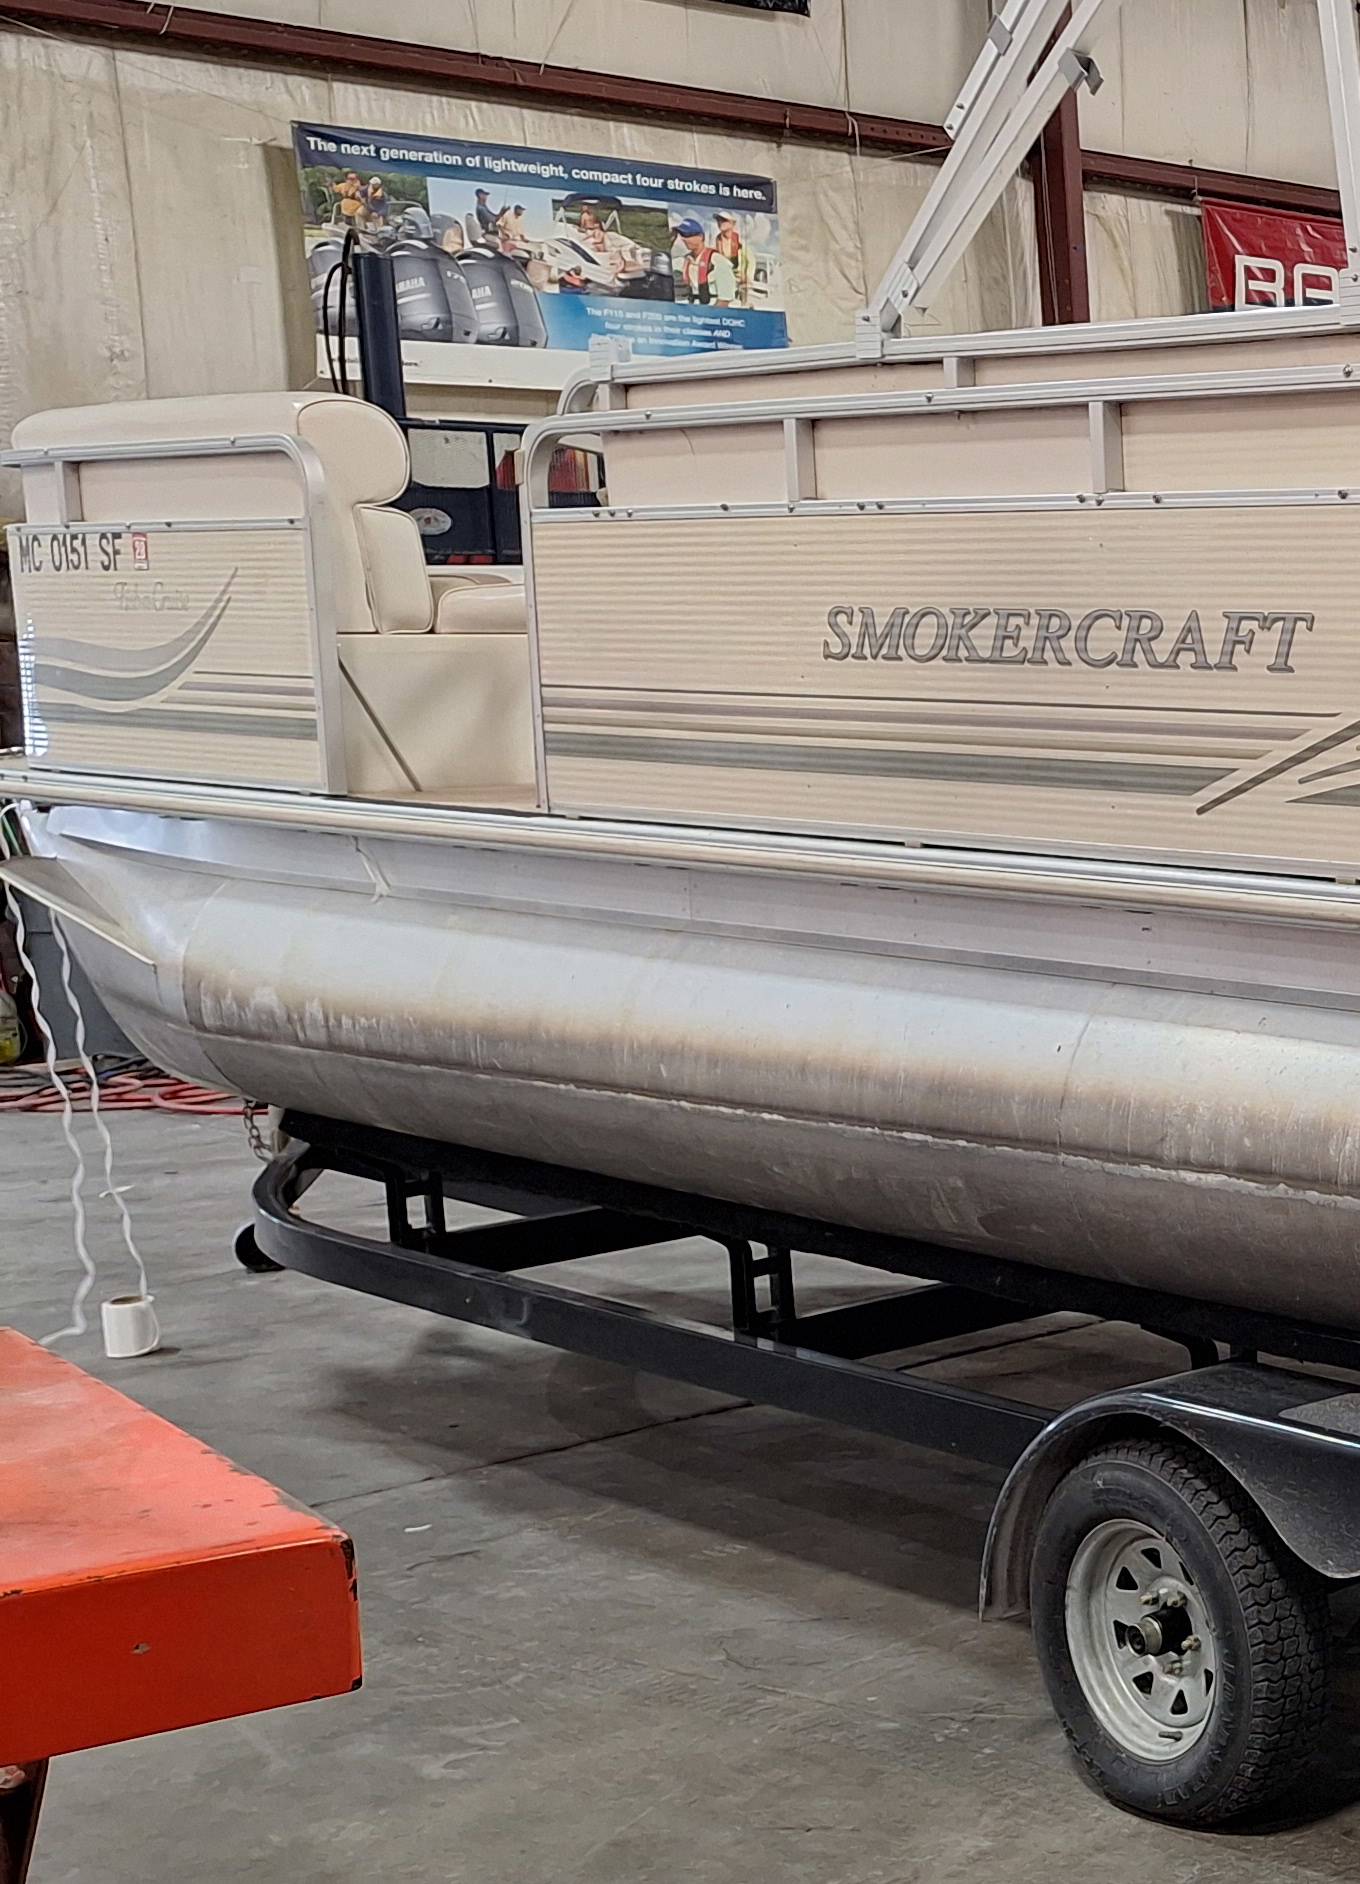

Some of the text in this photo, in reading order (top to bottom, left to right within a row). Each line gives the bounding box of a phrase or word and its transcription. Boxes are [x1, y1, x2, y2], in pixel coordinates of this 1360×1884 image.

[306, 136, 766, 201] The next generation of lightweight, compact four strokes is here.
[18, 532, 123, 573] MC 0151 SF
[823, 605, 1316, 673] SMOKERCRAFT
